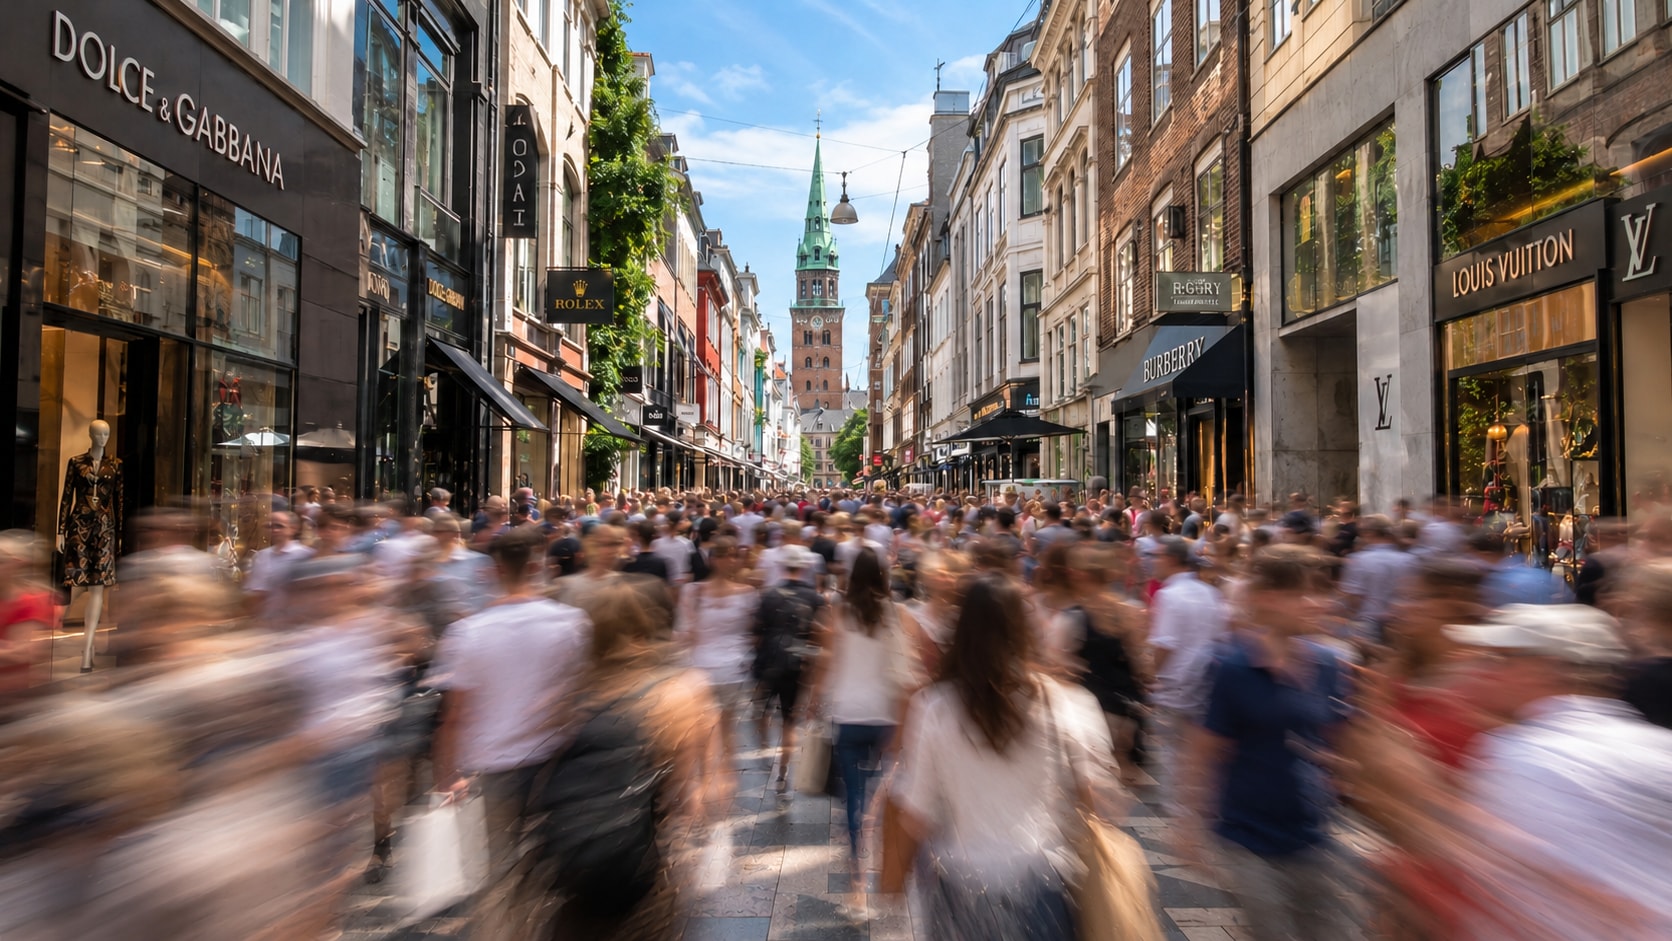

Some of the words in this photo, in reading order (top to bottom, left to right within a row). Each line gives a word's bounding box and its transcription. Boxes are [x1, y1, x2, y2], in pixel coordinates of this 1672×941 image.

[52, 9, 155, 113] DOLCE
[158, 97, 171, 123] &
[174, 93, 285, 191] GABBANA
[1452, 258, 1495, 299] LOUIS
[1498, 228, 1576, 282] VUITTON
[554, 298, 605, 310] ROLEX
[1143, 336, 1205, 383] BURBERRY
